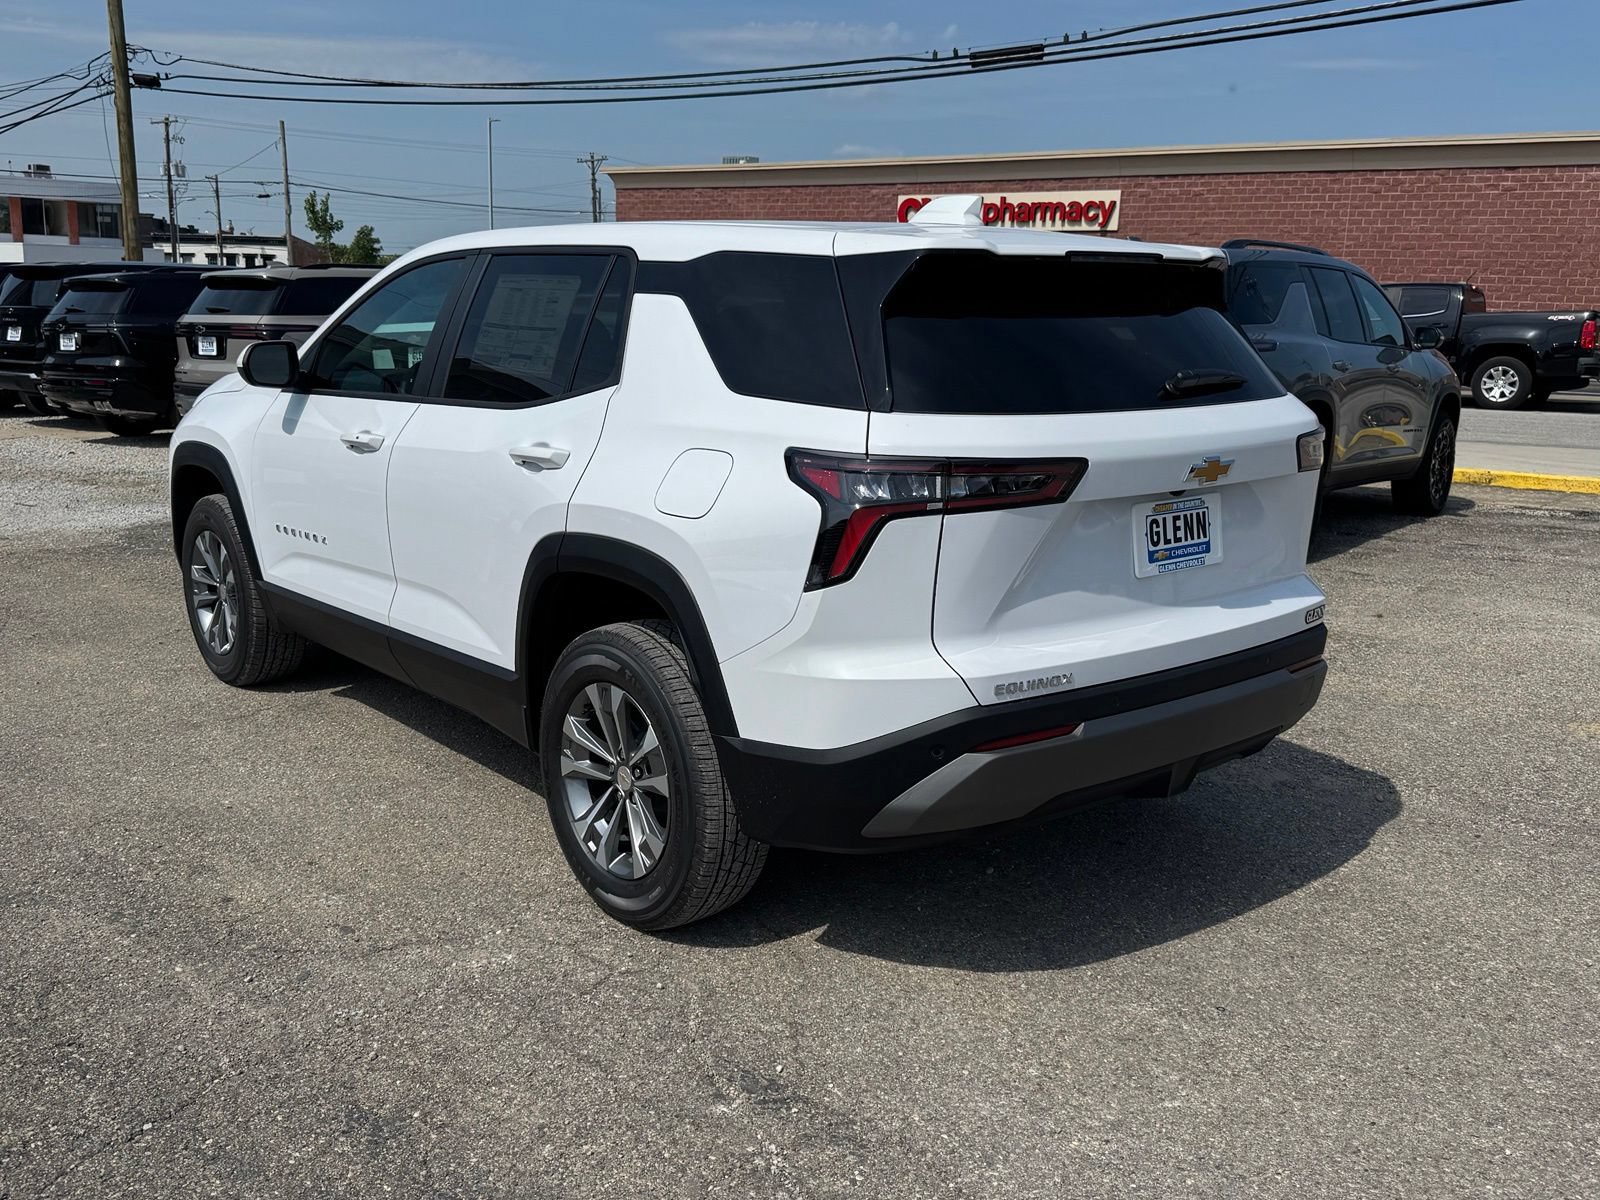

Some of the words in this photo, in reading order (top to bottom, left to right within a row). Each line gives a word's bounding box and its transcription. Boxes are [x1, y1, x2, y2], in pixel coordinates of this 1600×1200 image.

[982, 196, 1114, 228] pharmacy
[1149, 511, 1207, 547] GLENN
[1171, 545, 1206, 556] CHEVROLET
[1159, 564, 1176, 573] GLENN
[1176, 558, 1204, 569] CHEVROLET
[993, 672, 1073, 697] EQUINOX
